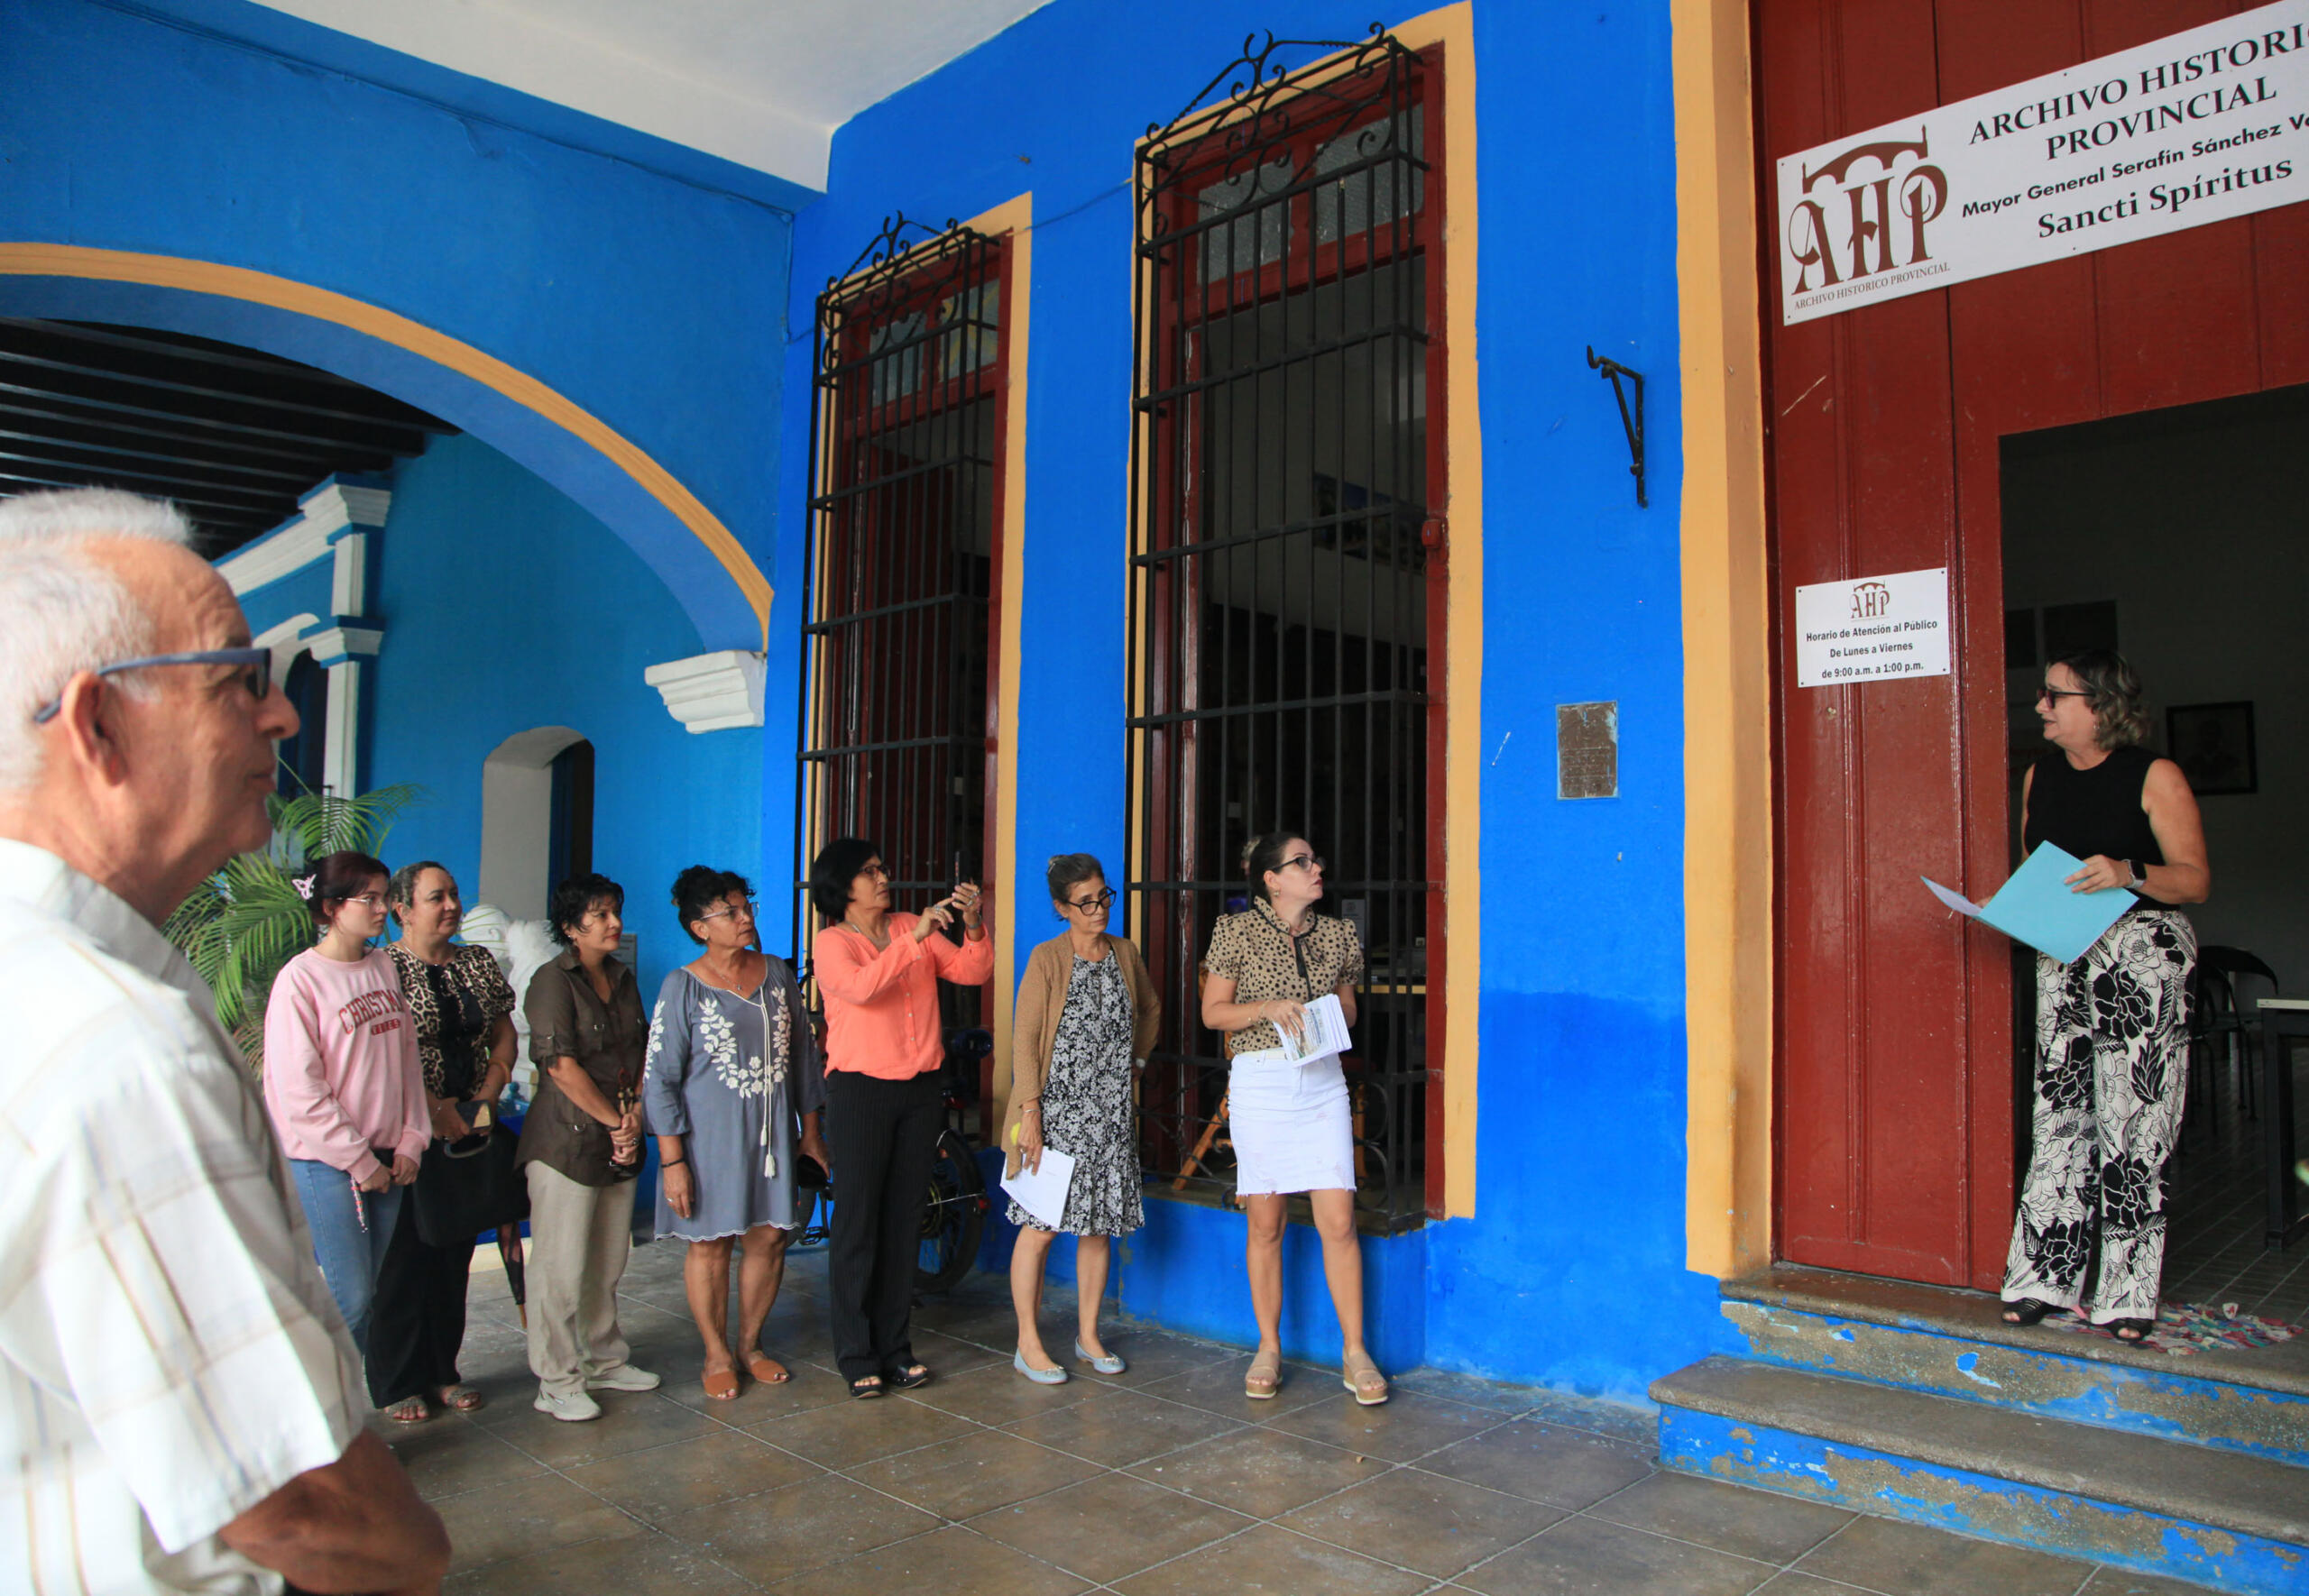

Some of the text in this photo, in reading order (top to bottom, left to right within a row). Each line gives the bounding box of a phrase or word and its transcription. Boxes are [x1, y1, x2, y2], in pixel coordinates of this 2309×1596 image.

[1969, 23, 2309, 145] ARCHIVO HISTORI
[2046, 77, 2277, 161] PROVINCIAL
[1962, 194, 2021, 217] Mayor
[2028, 167, 2104, 199] General
[2111, 150, 2184, 179] Serafín
[2192, 124, 2282, 157] Sánchez
[2038, 160, 2293, 238] Sancti Spíritus
[1789, 164, 1948, 296] AHP
[1793, 261, 1951, 310] ARCHIVO HISTORICO PROVINCIAL
[1806, 619, 1937, 642] Horario de Atención al Público
[1849, 590, 1890, 619] AHP
[1821, 662, 1924, 679] de 9:00 a.m. a 1:00 p.m.
[1830, 641, 1913, 658] De Lunes a Viernes
